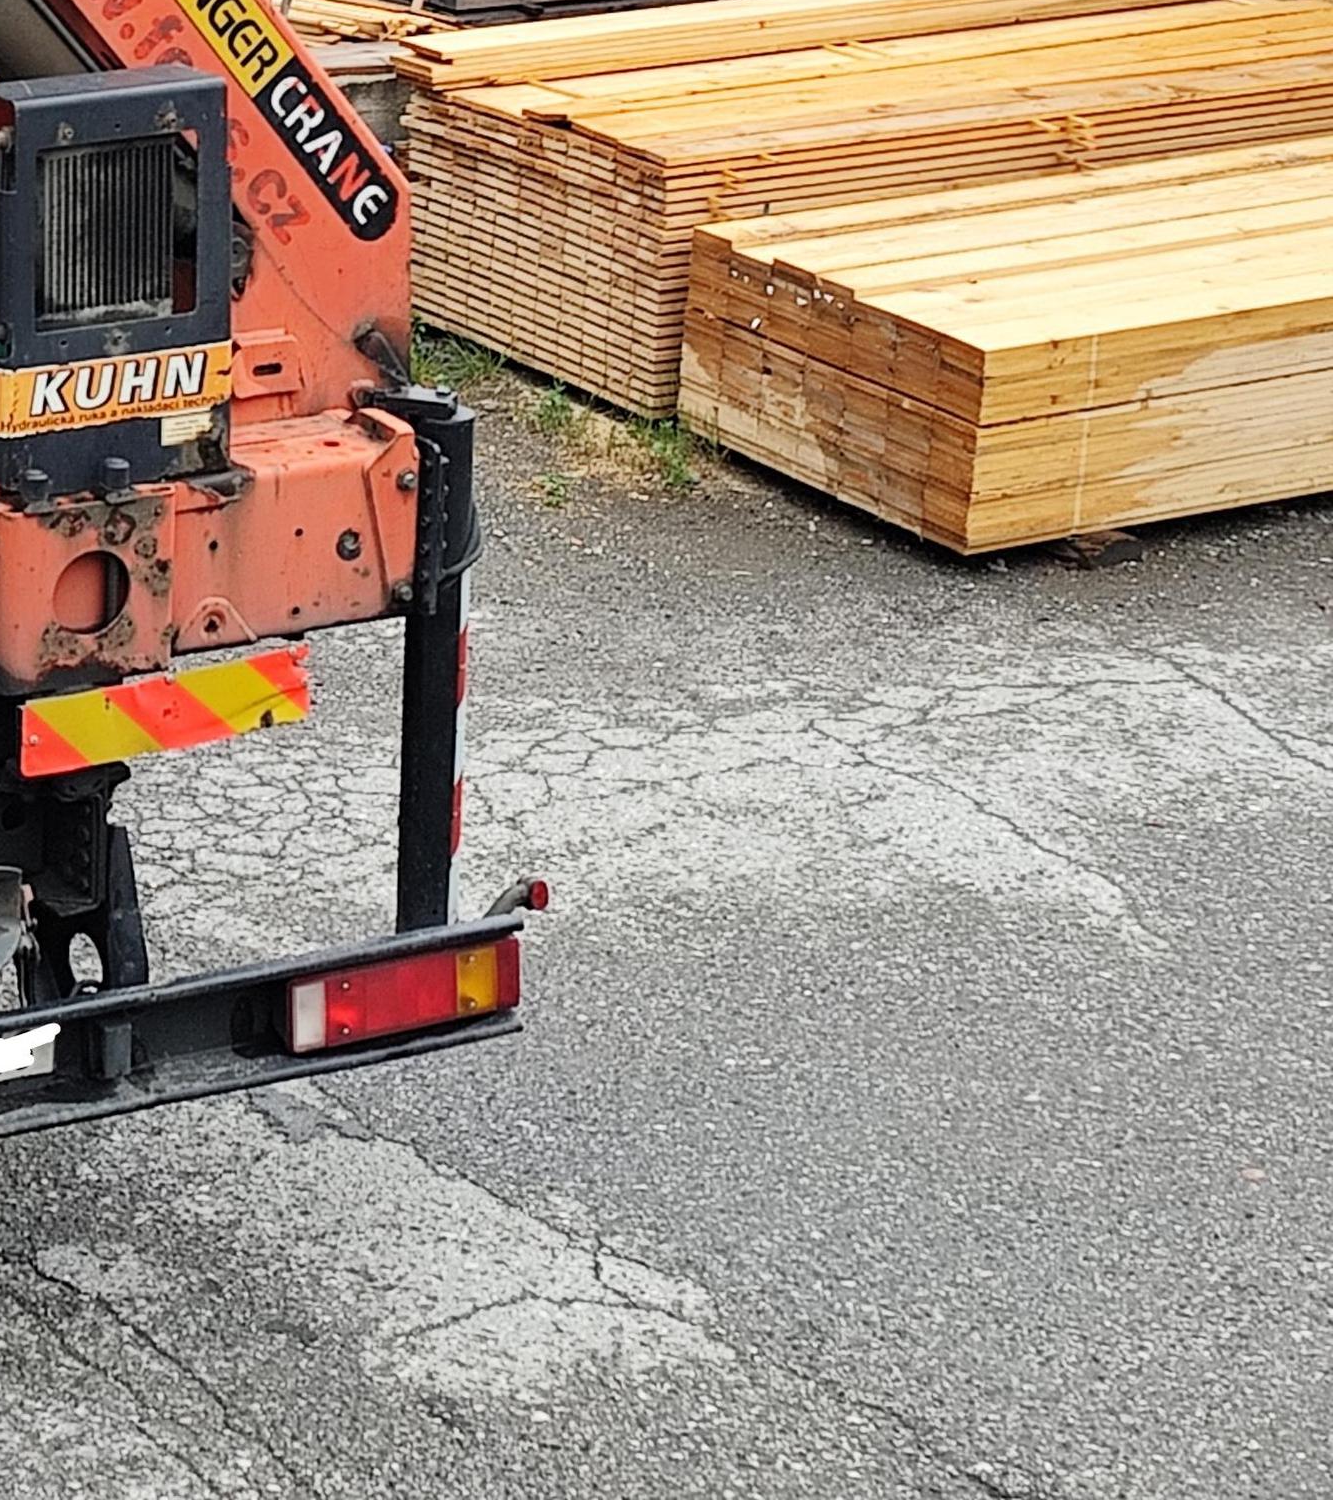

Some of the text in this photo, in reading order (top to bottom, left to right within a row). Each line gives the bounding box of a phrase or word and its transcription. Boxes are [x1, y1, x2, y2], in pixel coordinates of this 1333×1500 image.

[271, 74, 389, 226] CRANE
[30, 351, 208, 418] KUHN
[79, 409, 106, 422] ruka
